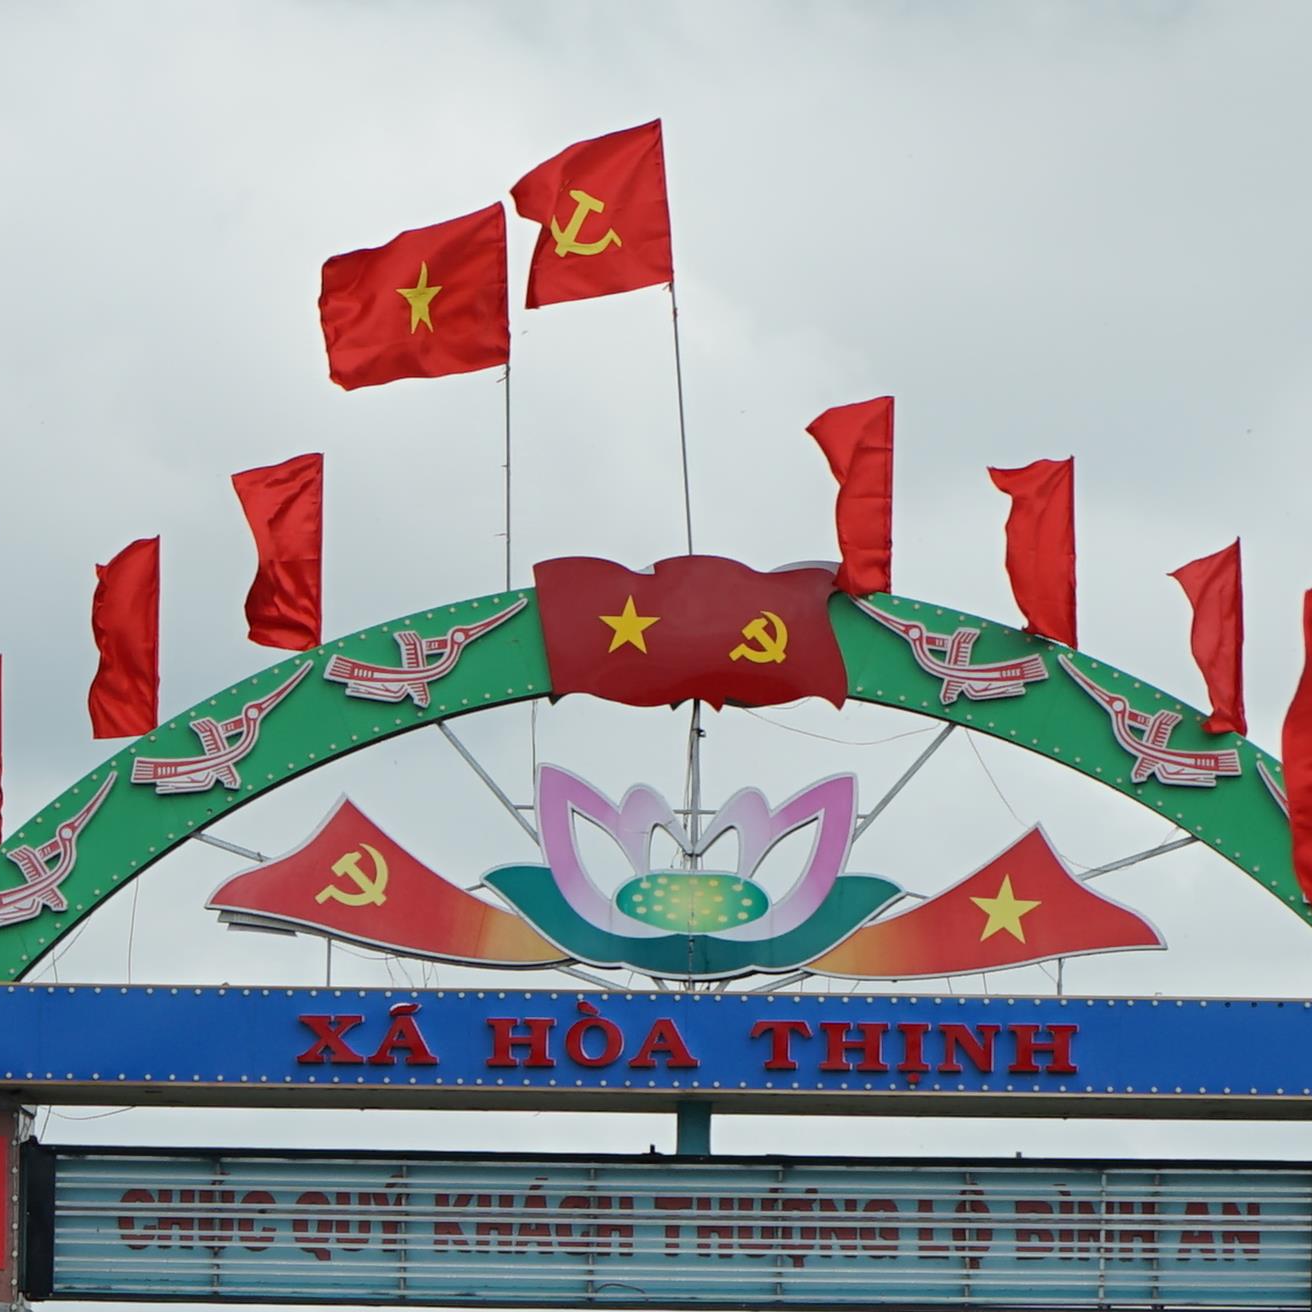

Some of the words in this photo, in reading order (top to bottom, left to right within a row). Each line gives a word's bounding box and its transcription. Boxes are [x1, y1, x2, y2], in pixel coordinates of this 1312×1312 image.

[485, 1000, 701, 1068] HÒA
[749, 1020, 1080, 1084] THỊNH
[118, 1171, 277, 1252] CHÚC
[293, 1172, 409, 1261] QUÝ
[433, 1177, 634, 1256] KHÁCH
[654, 1187, 900, 1268] THƯỢNG
[918, 1182, 993, 1269] LỘ
[1015, 1183, 1159, 1262] BÌNH
[1177, 1202, 1261, 1261] AN
